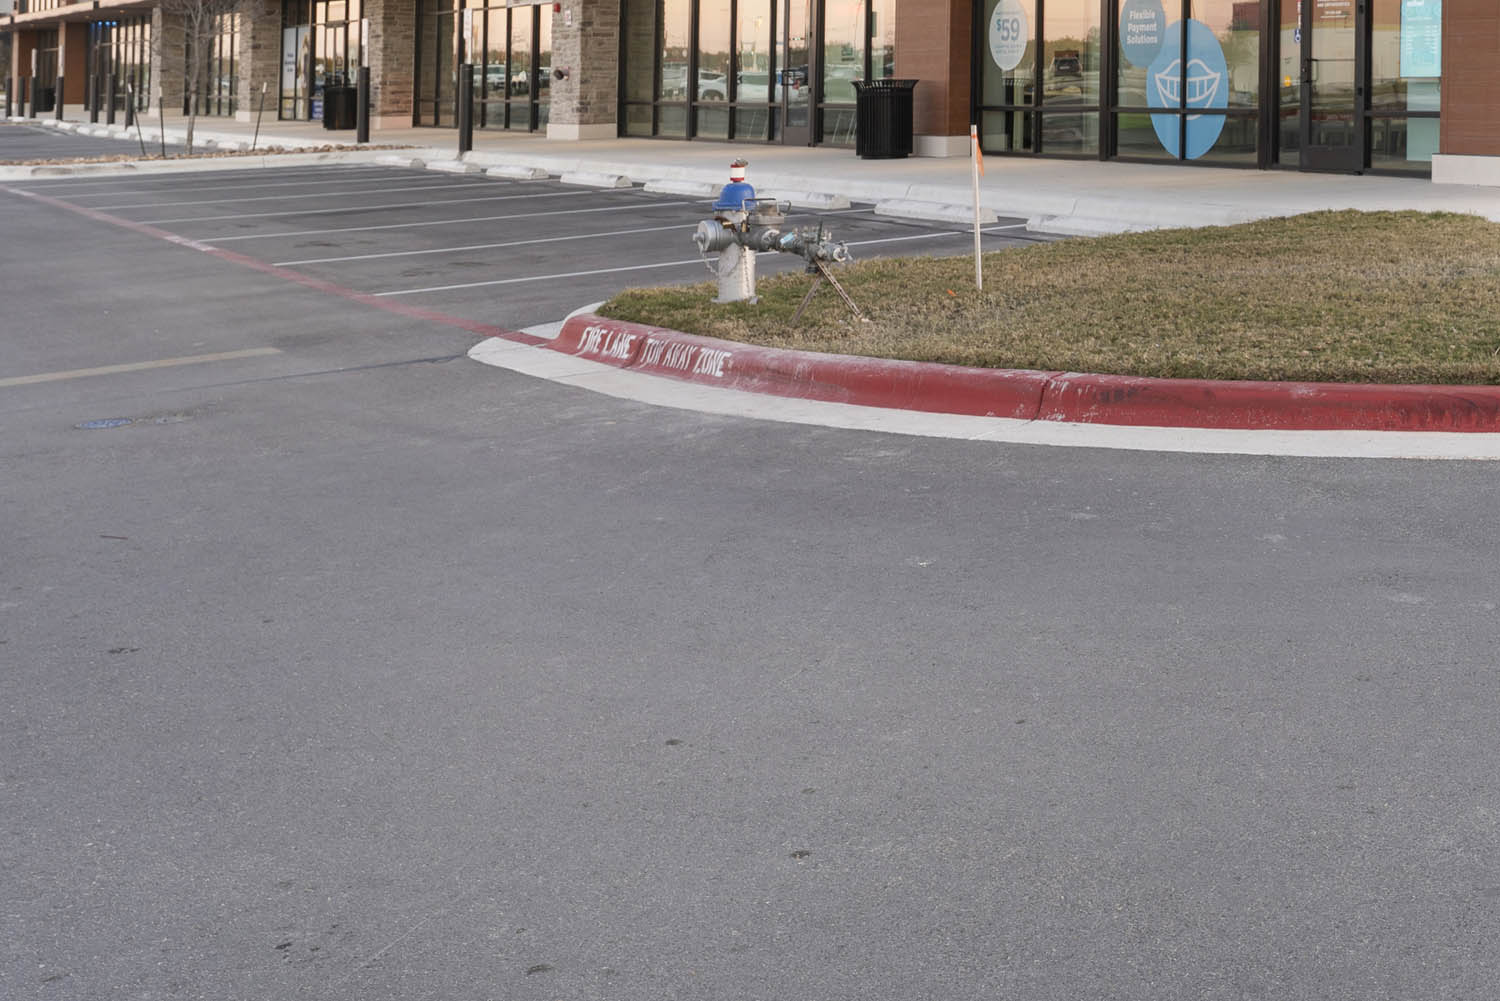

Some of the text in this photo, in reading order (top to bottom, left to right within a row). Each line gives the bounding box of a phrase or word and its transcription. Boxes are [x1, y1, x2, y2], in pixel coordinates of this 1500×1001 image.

[996, 18, 1020, 41] $59
[577, 326, 608, 353] FIRE
[603, 331, 637, 360] LANE
[692, 348, 733, 377] ZONE
